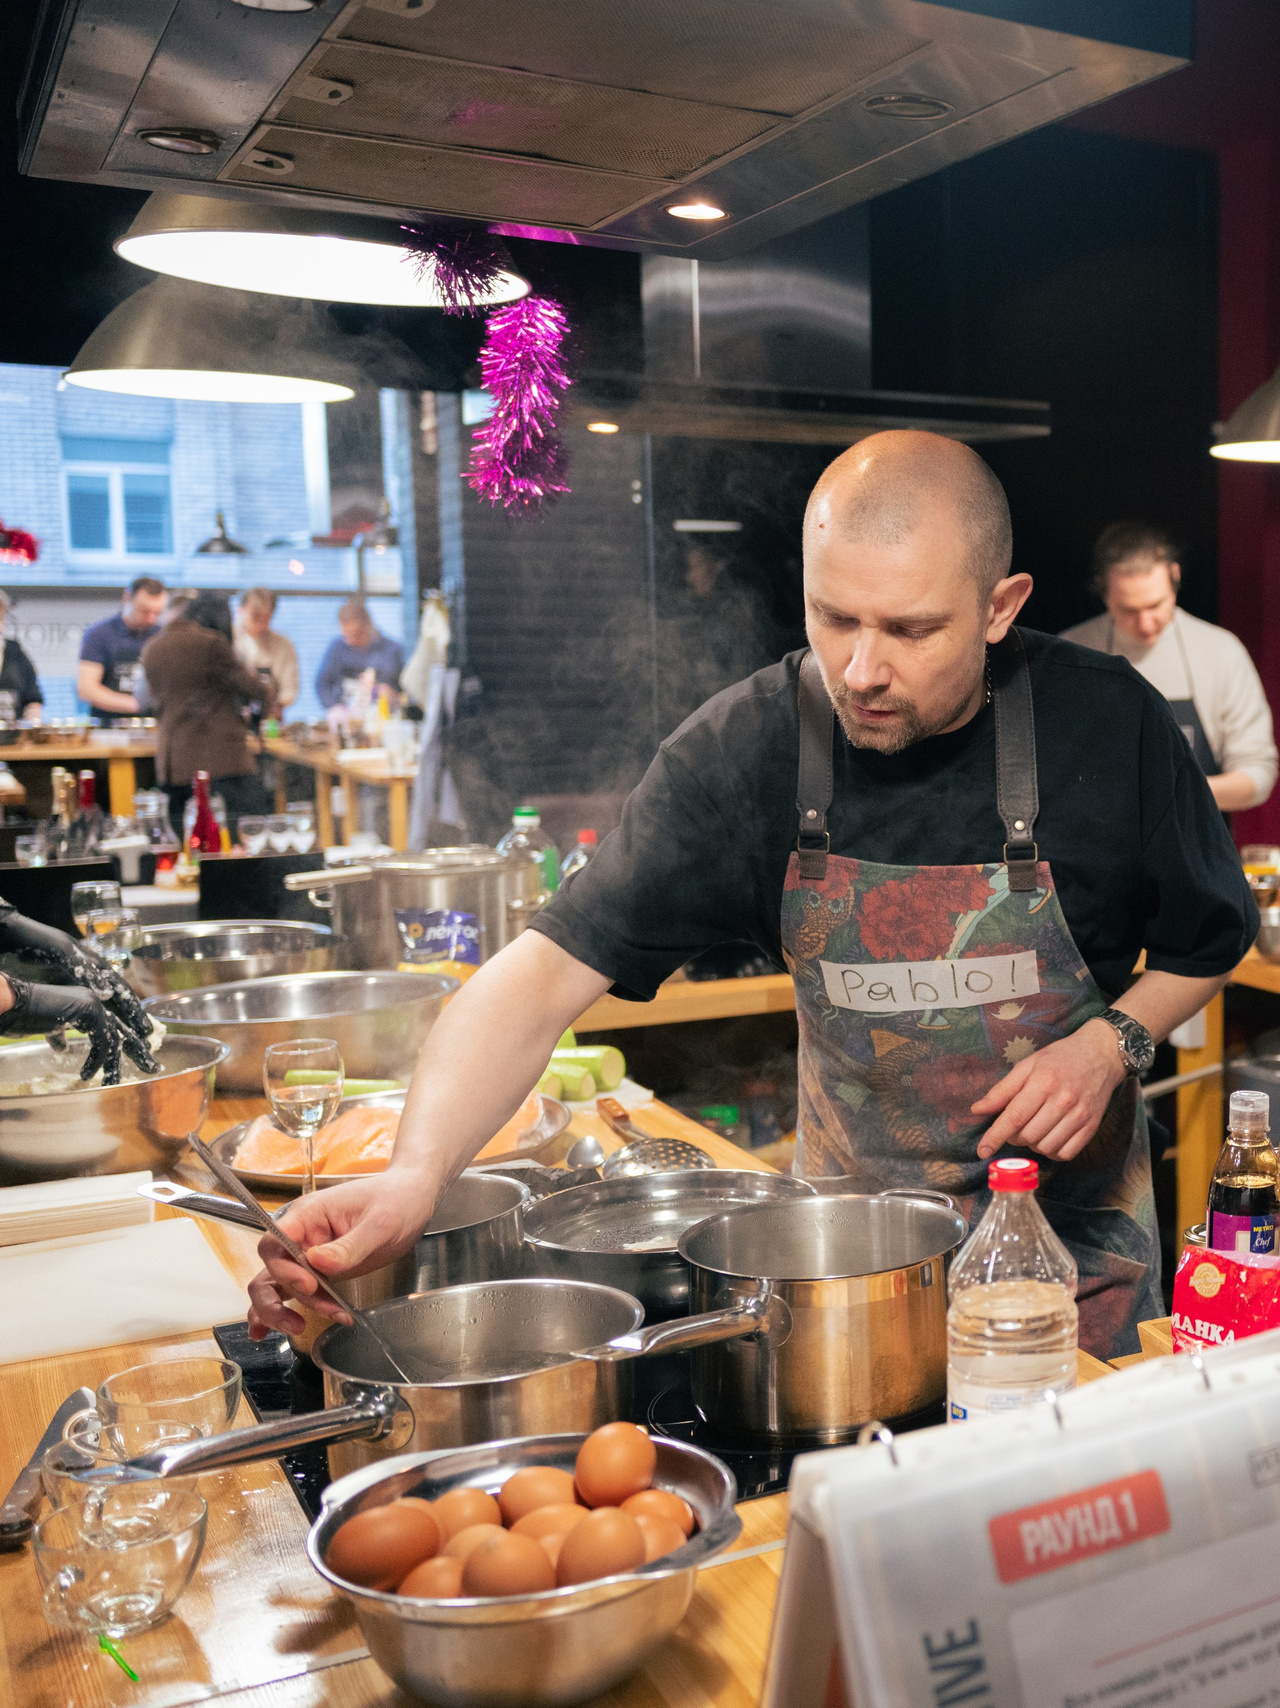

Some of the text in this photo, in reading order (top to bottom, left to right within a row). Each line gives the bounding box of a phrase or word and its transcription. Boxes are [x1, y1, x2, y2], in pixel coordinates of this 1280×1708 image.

[841, 959, 1016, 1004] Pablo!
[1255, 1236, 1271, 1247] Chef
[1171, 1312, 1235, 1346] МАНКА
[1019, 1489, 1138, 1565] РАУНД 1
[923, 1617, 995, 1708] IVE
